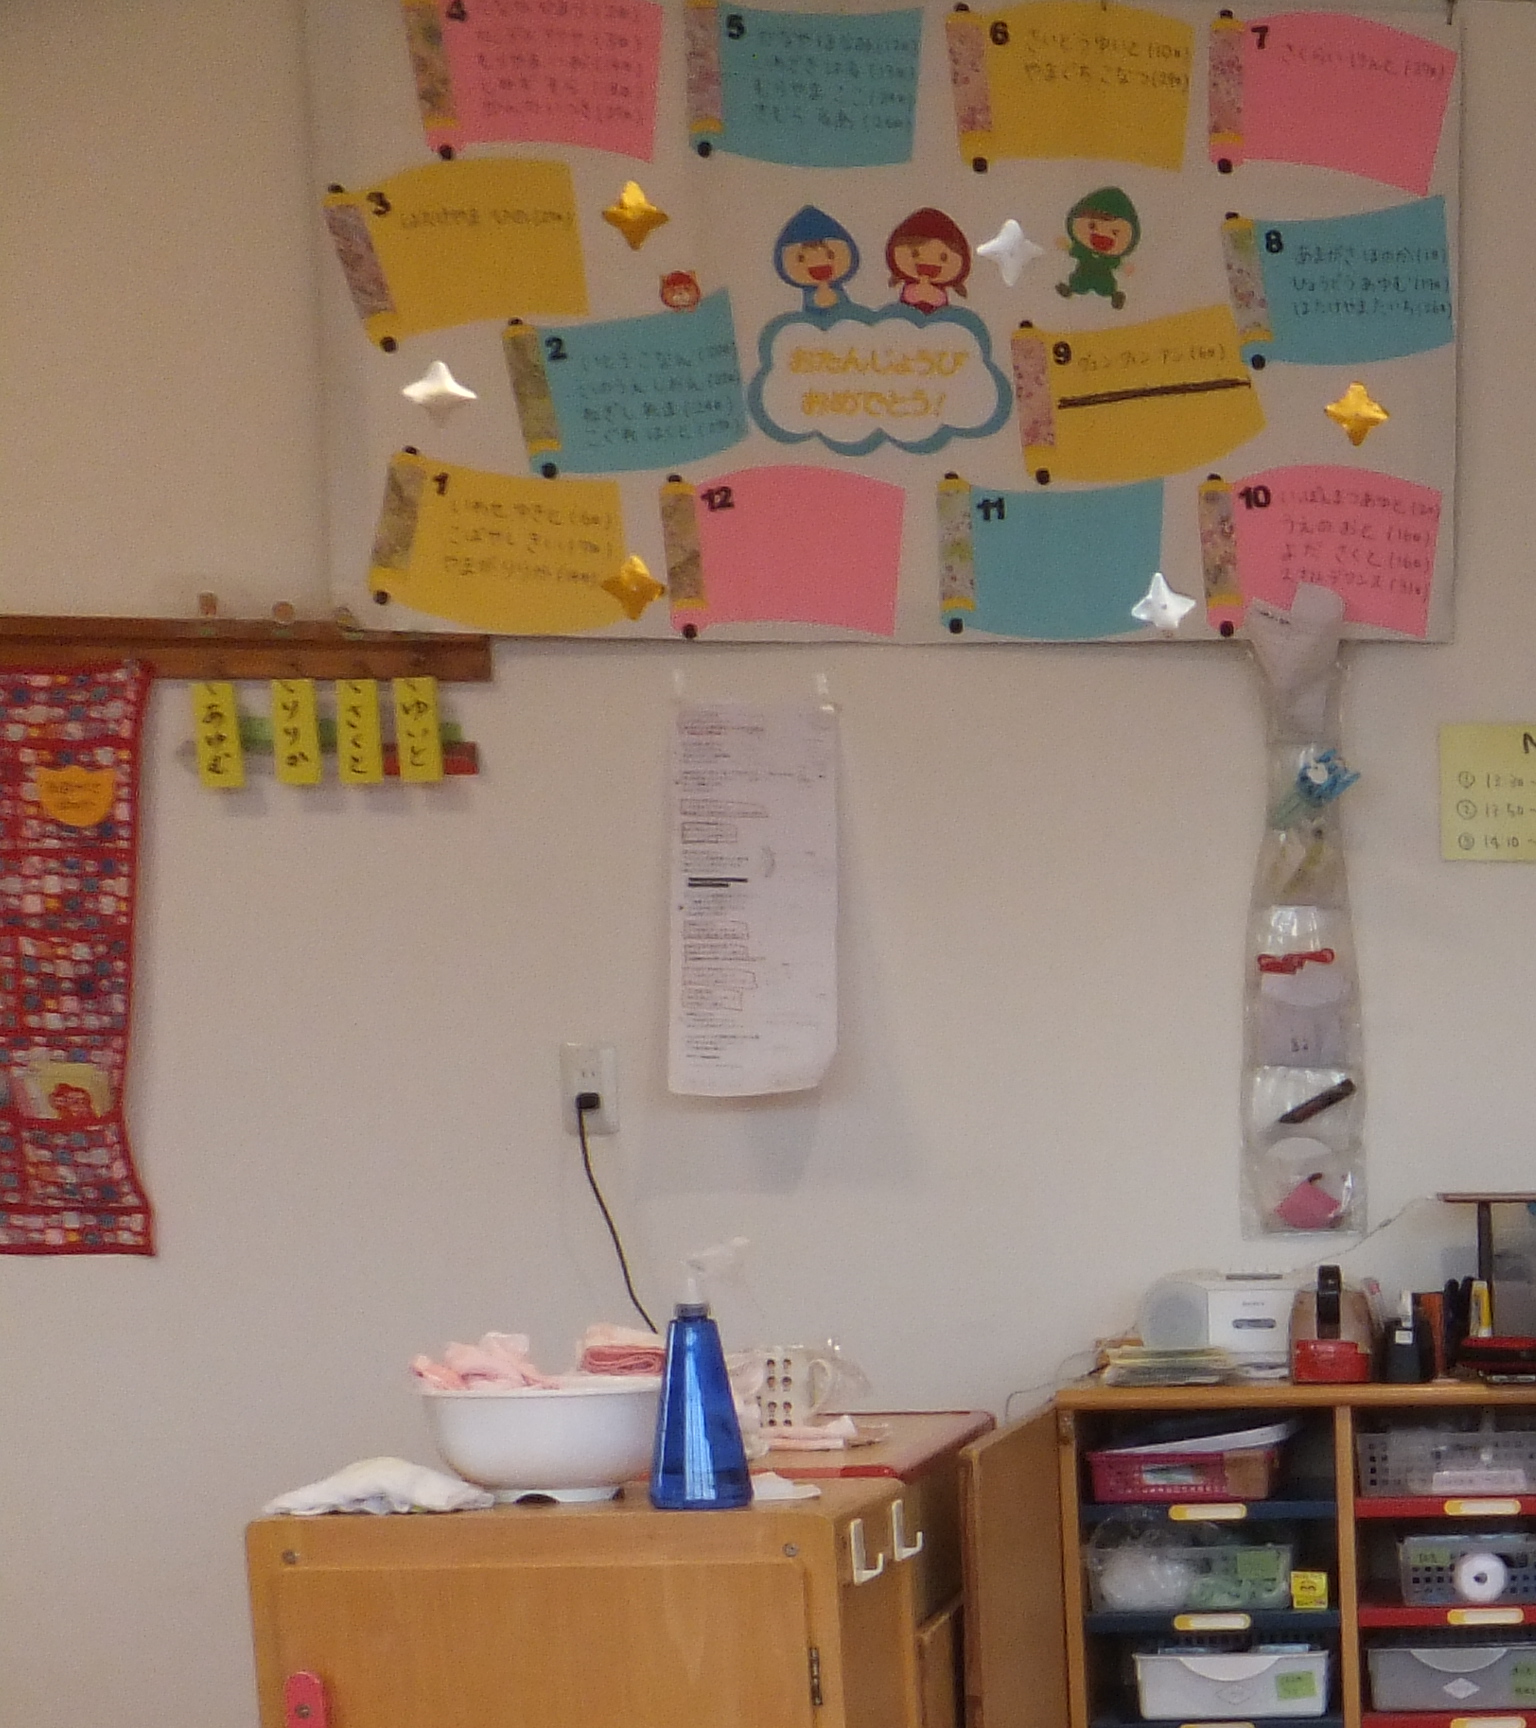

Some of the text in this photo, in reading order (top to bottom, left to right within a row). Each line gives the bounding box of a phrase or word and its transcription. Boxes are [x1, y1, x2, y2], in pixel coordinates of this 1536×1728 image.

[726, 15, 744, 38] 5
[989, 24, 1009, 45] 6
[1252, 26, 1269, 48] 7
[367, 192, 391, 216] 3
[1266, 231, 1283, 253] 8
[544, 338, 567, 360] 2
[1053, 342, 1071, 364] 9
[432, 473, 449, 496] 1
[701, 487, 735, 511] 12
[1239, 485, 1271, 509] 10
[977, 499, 1006, 521] 11
